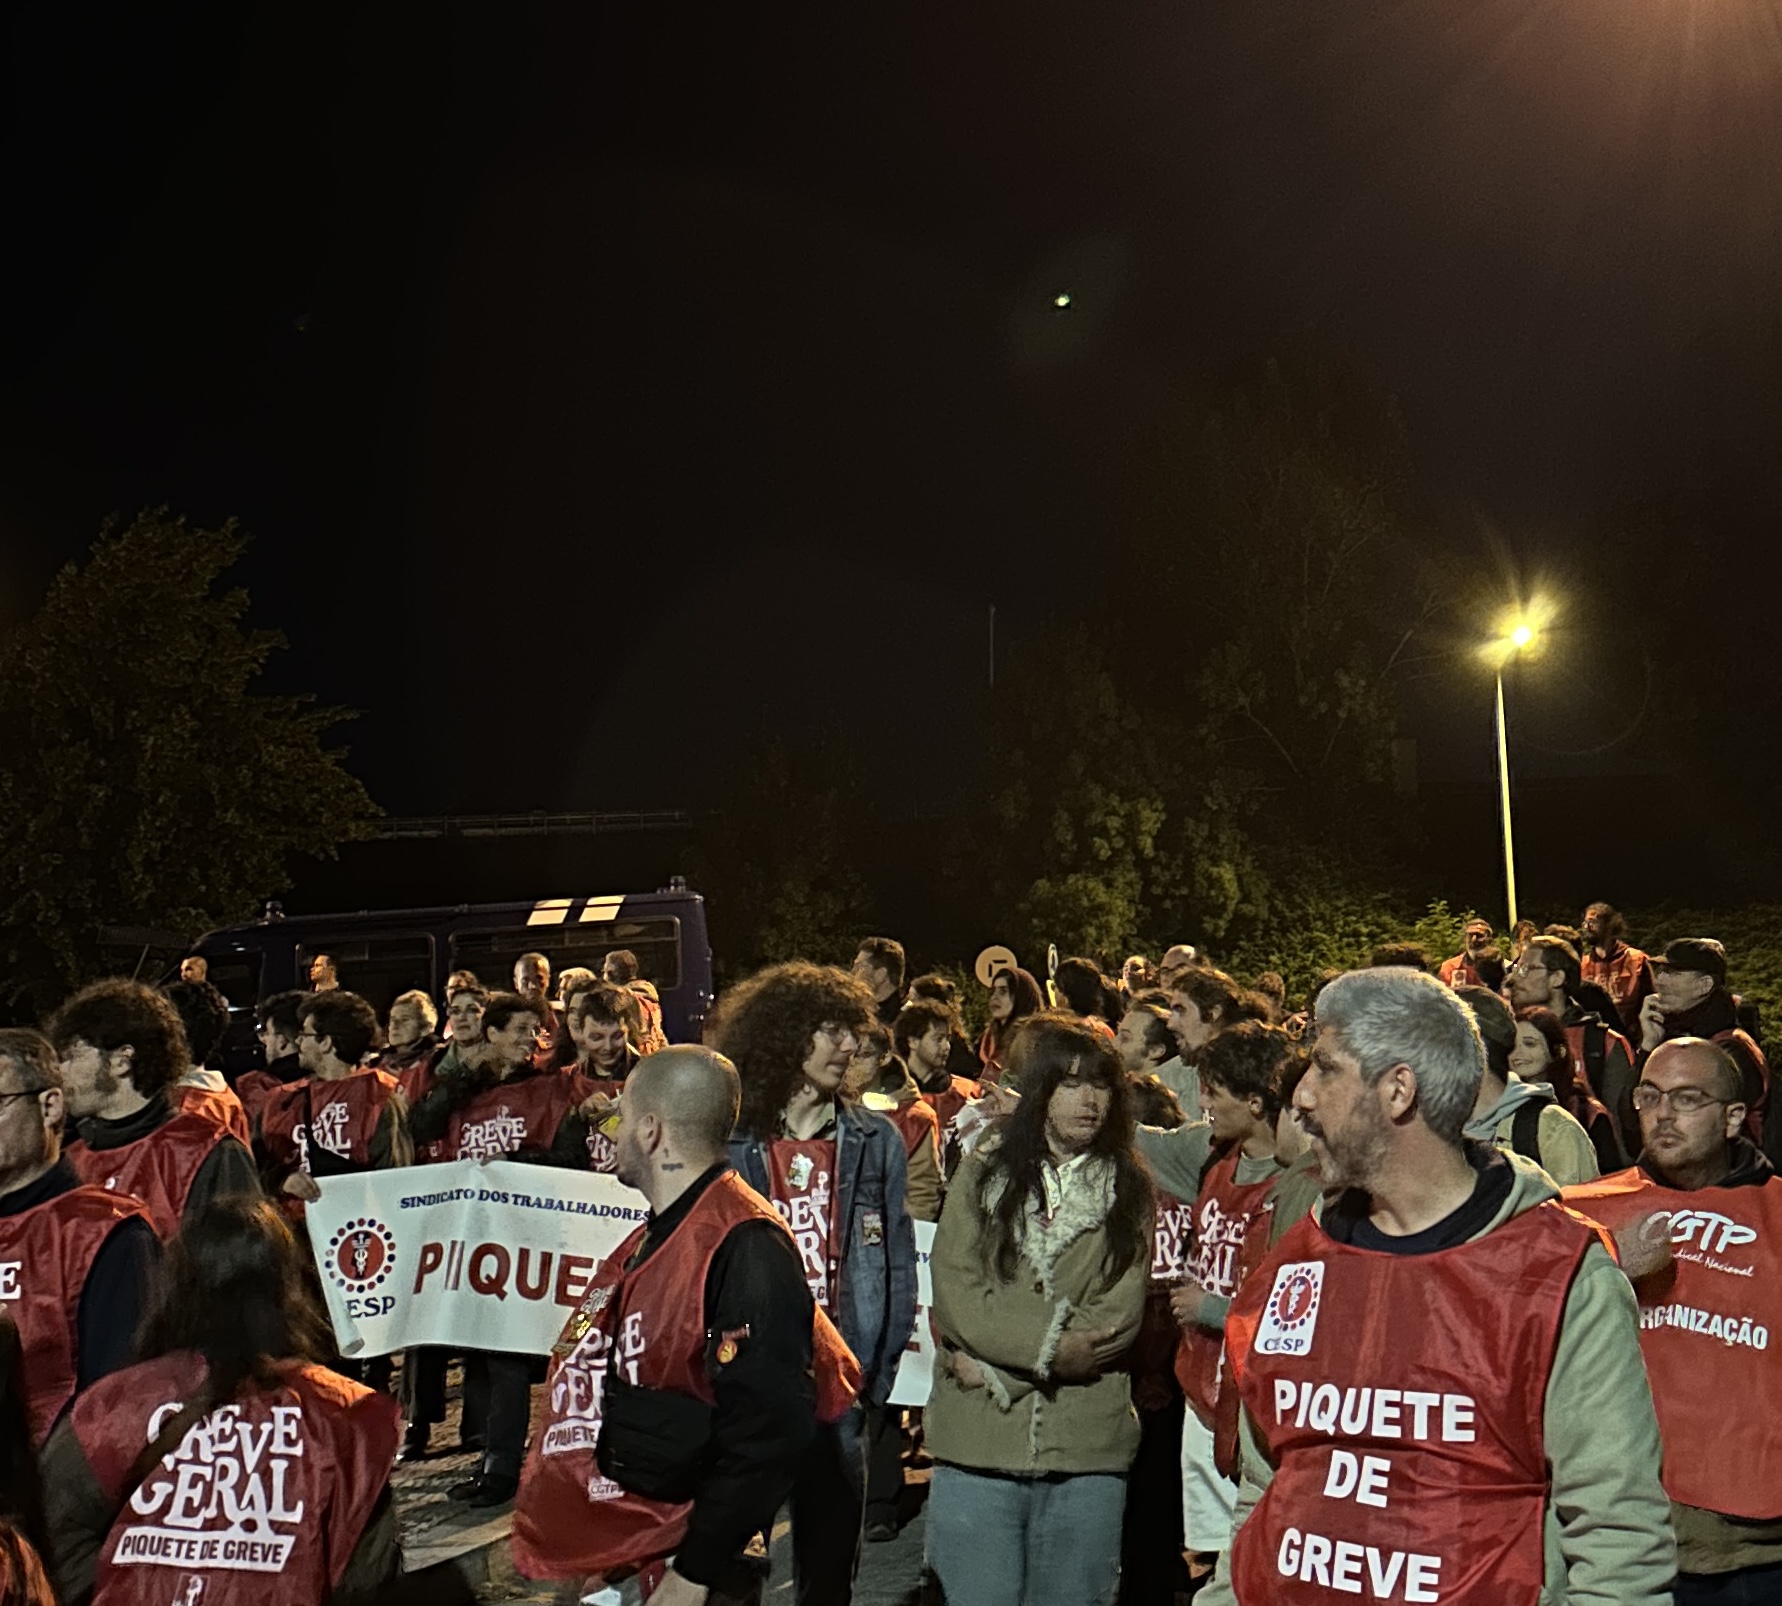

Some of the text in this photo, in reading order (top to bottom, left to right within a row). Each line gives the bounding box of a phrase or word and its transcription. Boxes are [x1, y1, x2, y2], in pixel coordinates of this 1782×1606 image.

[400, 1188, 651, 1222] SINDICATO DOS TRABALHADORES
[412, 1239, 607, 1308] PIQUE
[1704, 1256, 1755, 1278] Nacional
[345, 1295, 396, 1319] ESP
[1640, 1303, 1769, 1350] RGANIZAÇÃO
[1274, 1378, 1476, 1442] PIQUETE
[1323, 1449, 1392, 1509] DE
[120, 1535, 284, 1564] PIQUETE DE GREVE
[1277, 1527, 1442, 1604] GREVE
